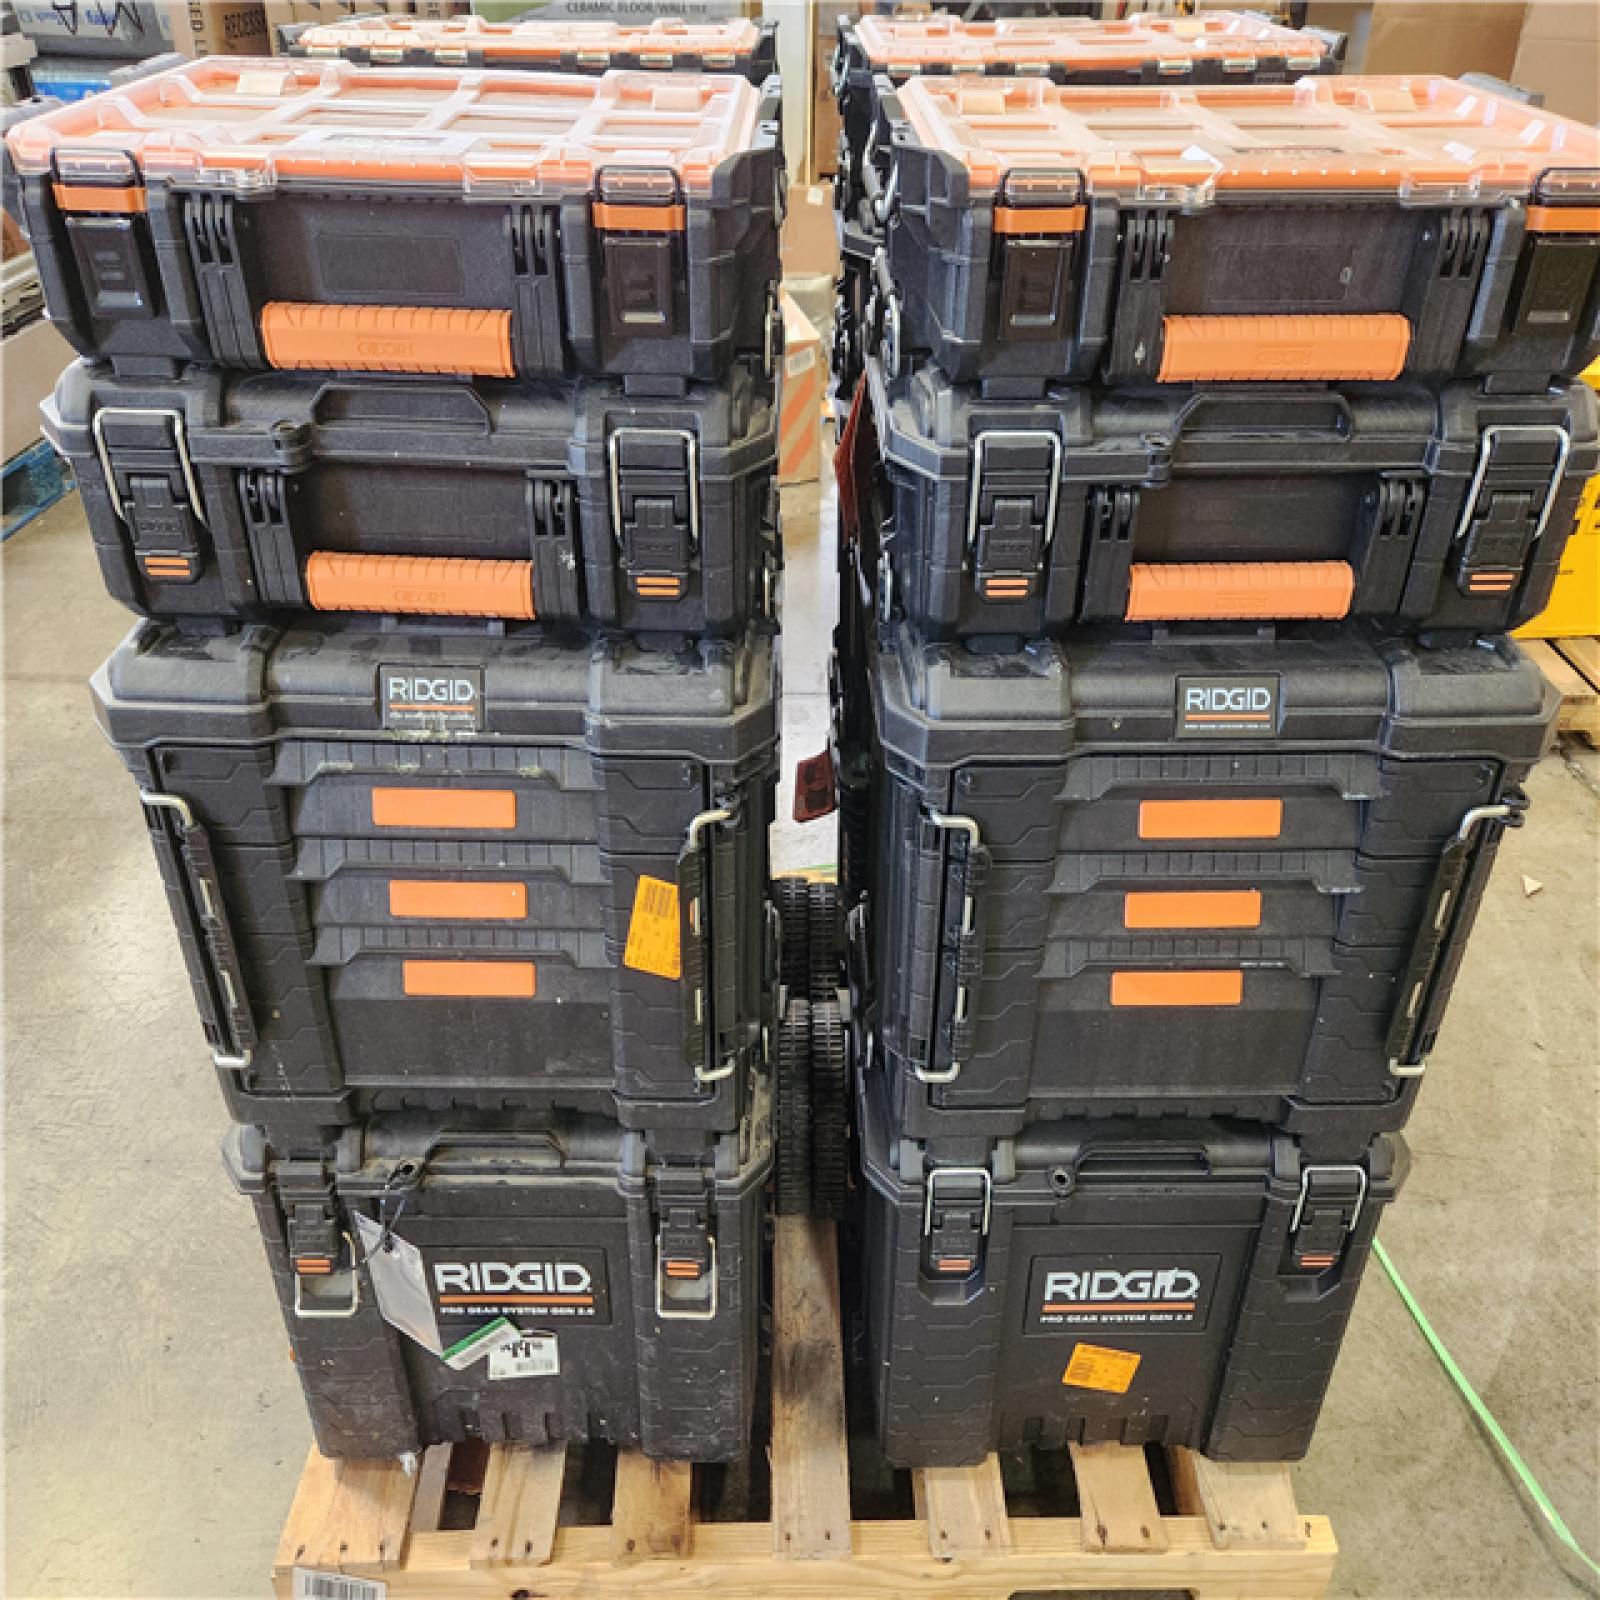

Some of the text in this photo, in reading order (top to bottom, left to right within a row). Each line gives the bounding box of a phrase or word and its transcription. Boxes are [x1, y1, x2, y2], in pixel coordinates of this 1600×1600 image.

[389, 677, 475, 701] RIDGID
[1184, 687, 1271, 711] RIDGID
[434, 1262, 592, 1293] RIDGID
[1045, 1269, 1200, 1301] RIDGID
[440, 1306, 465, 1315] PRO
[467, 1306, 498, 1315] GEAR
[502, 1306, 548, 1315] SYSTEM
[551, 1306, 575, 1315] GEN
[1040, 1315, 1063, 1324] PRO
[1067, 1315, 1098, 1324] GEAR
[1101, 1314, 1146, 1323] SYSTEM
[1150, 1314, 1173, 1322] GEN
